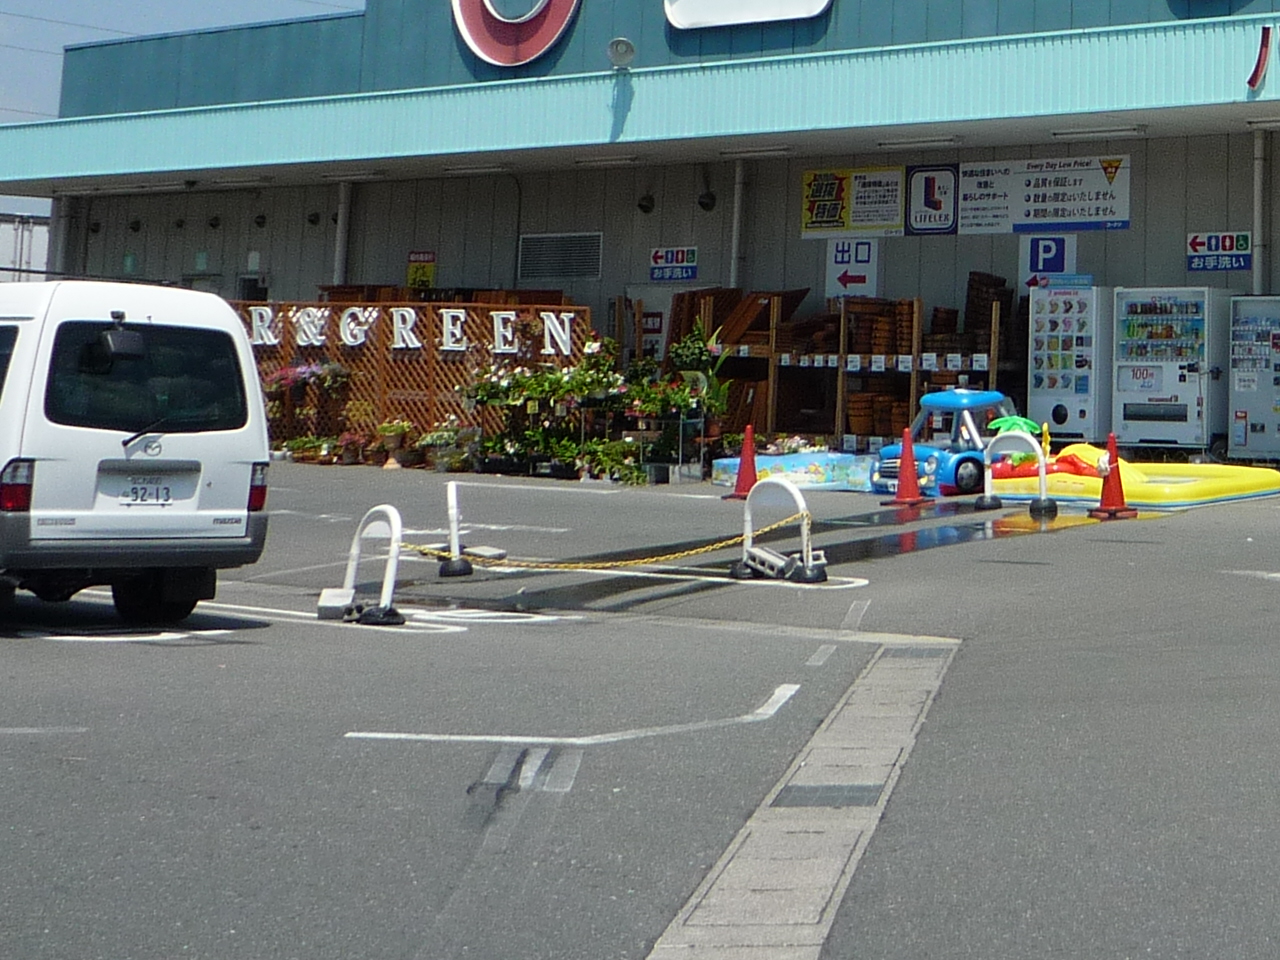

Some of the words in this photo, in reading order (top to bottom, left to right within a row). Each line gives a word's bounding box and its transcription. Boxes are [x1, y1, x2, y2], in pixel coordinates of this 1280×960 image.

[1026, 161, 1044, 170] Every
[1045, 161, 1057, 170] Day
[1058, 160, 1072, 169] Low
[1073, 159, 1092, 168] Price!
[834, 241, 871, 264] 出口
[1038, 239, 1057, 270] P
[1191, 255, 1245, 269] お手洗い
[652, 268, 692, 279] お手洗い
